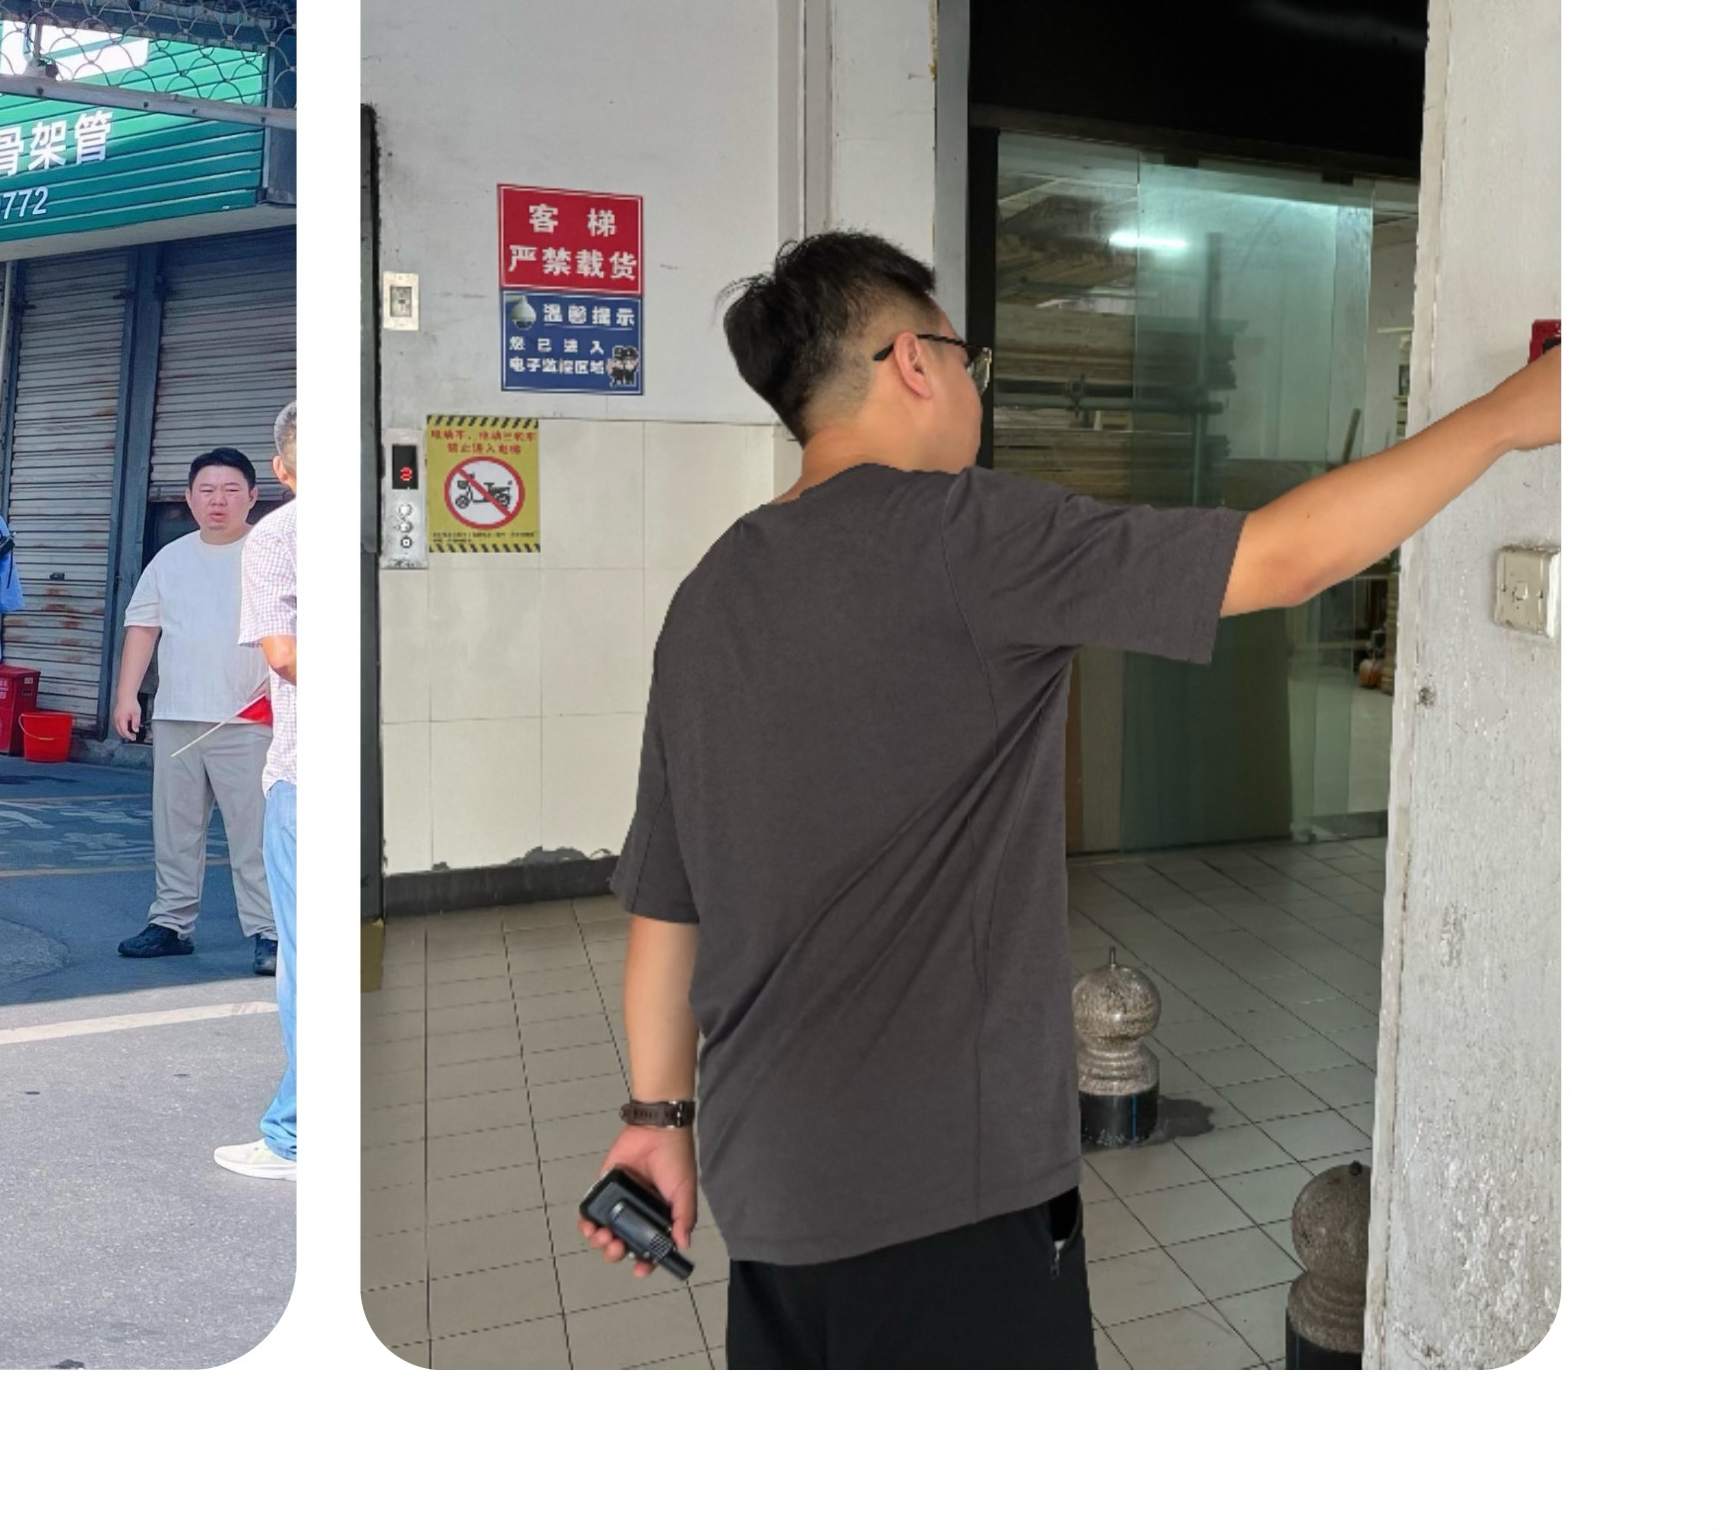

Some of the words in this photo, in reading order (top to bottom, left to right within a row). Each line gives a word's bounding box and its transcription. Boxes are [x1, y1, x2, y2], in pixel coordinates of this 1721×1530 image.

[508, 244, 638, 281] 严禁载货
[543, 303, 636, 327] 温馨提示
